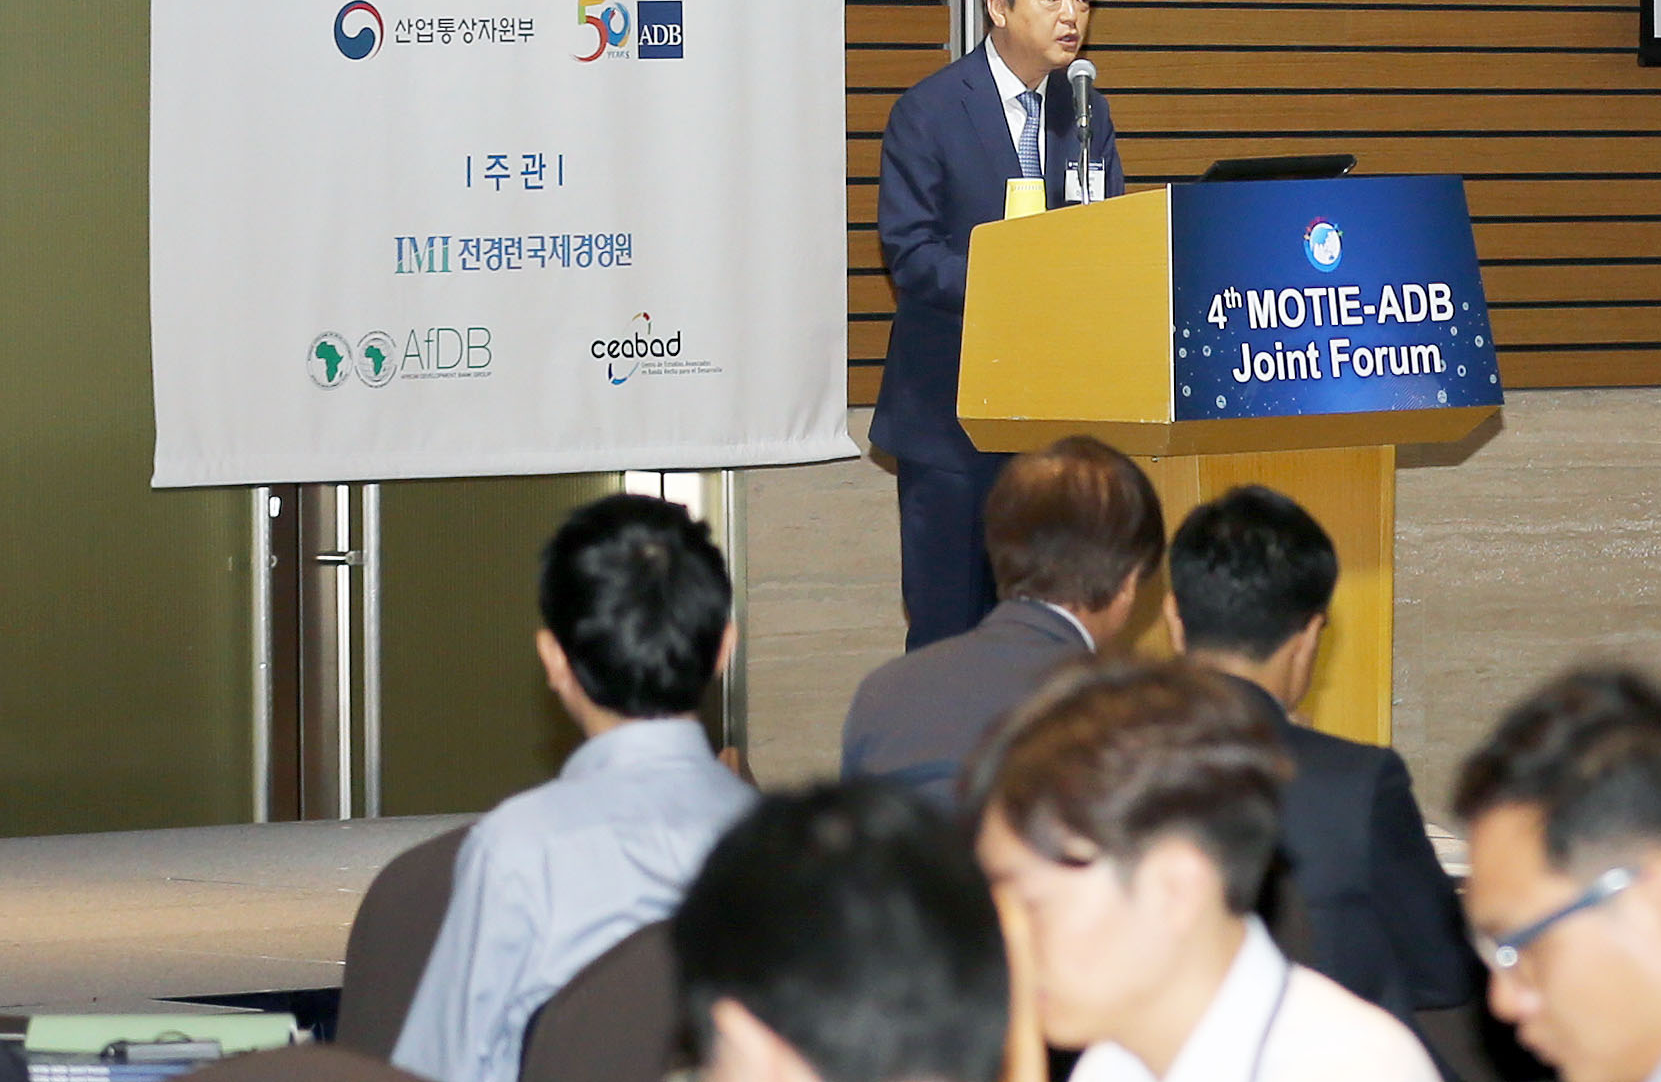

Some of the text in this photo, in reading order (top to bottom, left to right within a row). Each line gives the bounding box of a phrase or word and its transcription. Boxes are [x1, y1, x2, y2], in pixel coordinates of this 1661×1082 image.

[395, 18, 534, 44] 산업통상자원부
[639, 25, 681, 45] ADB
[394, 234, 632, 273] IMI 전경련국제경영원
[1208, 283, 1454, 329] 4th MOTIE-ADB
[401, 328, 491, 370] AfDB
[591, 331, 681, 358] ceabad
[1233, 339, 1442, 382] Joint Forum
